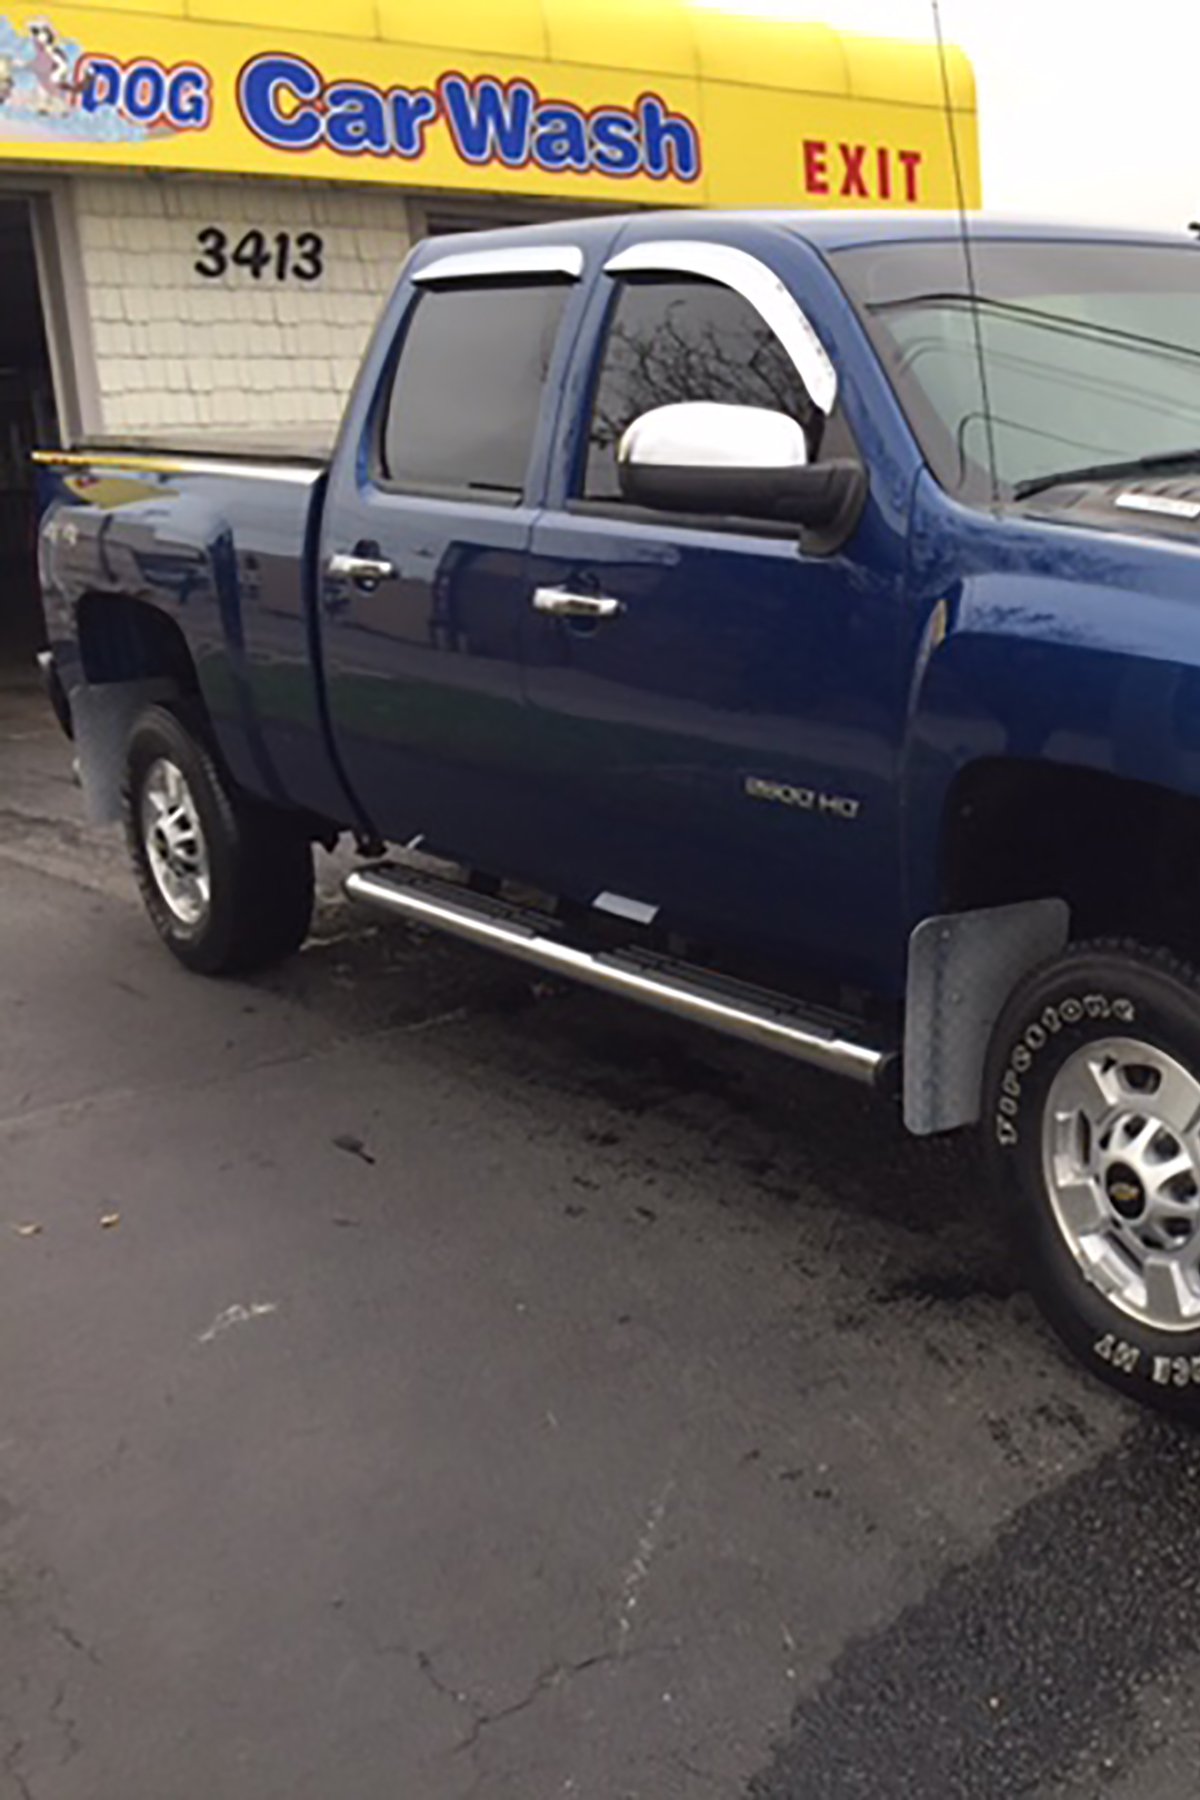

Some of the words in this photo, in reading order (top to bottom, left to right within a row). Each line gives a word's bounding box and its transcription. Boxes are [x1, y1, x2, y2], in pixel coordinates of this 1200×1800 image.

[79, 55, 210, 129] DOG
[803, 139, 921, 202] EXIT
[194, 226, 323, 281] 3413
